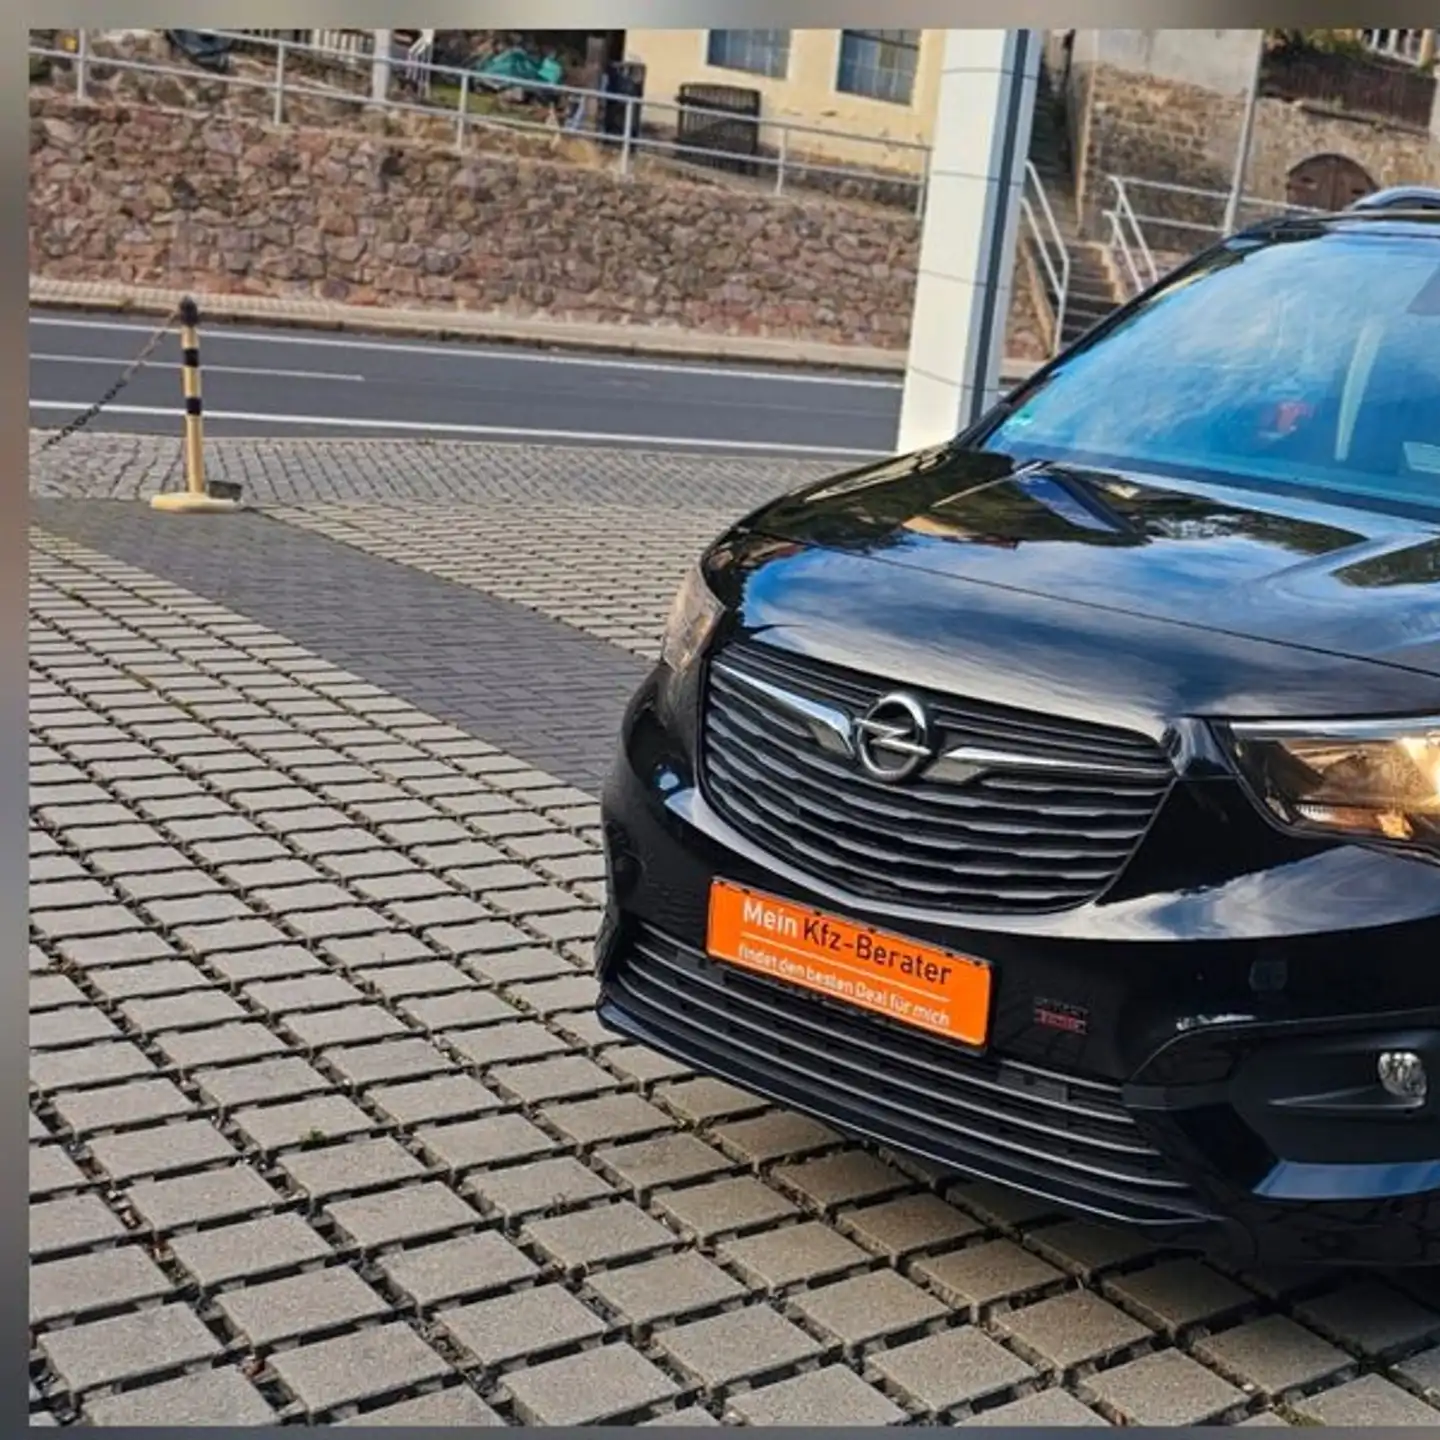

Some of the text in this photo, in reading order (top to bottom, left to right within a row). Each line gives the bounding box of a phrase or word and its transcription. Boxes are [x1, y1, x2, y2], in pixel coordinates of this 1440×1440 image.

[743, 898, 952, 985] Mein Kfz-Berater
[912, 1005, 950, 1027] mich
